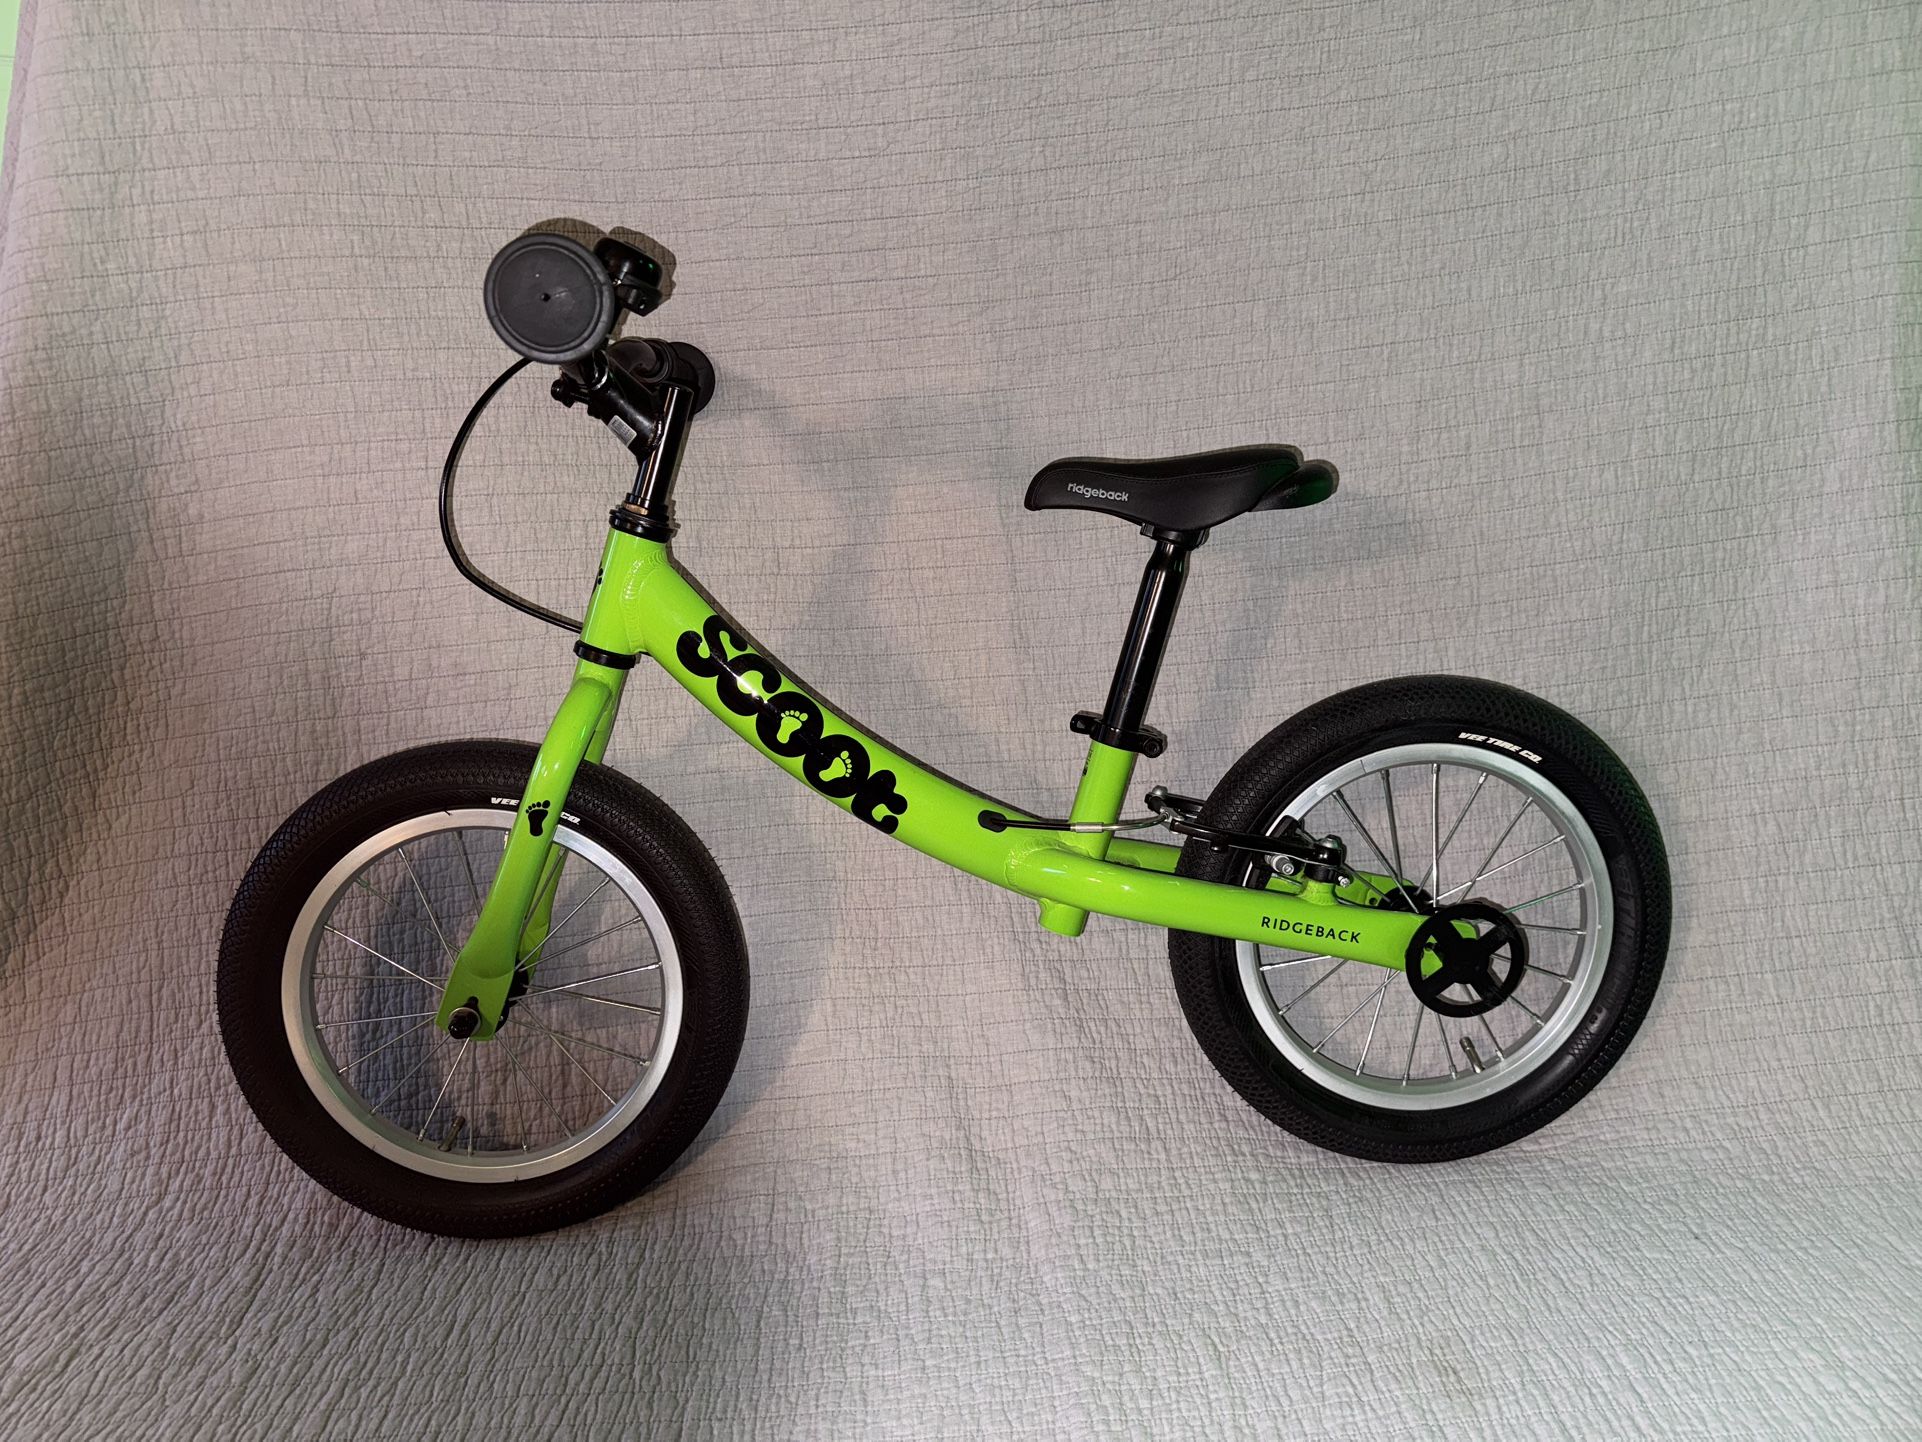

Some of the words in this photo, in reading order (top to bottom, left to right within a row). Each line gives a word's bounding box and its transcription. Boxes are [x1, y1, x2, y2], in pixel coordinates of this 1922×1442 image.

[1067, 483, 1129, 502] ridgeback
[1458, 732, 1488, 742] VEE
[1486, 737, 1522, 753] TIRE
[490, 797, 520, 806] VEE
[1261, 916, 1361, 943] RIDGEBACK
